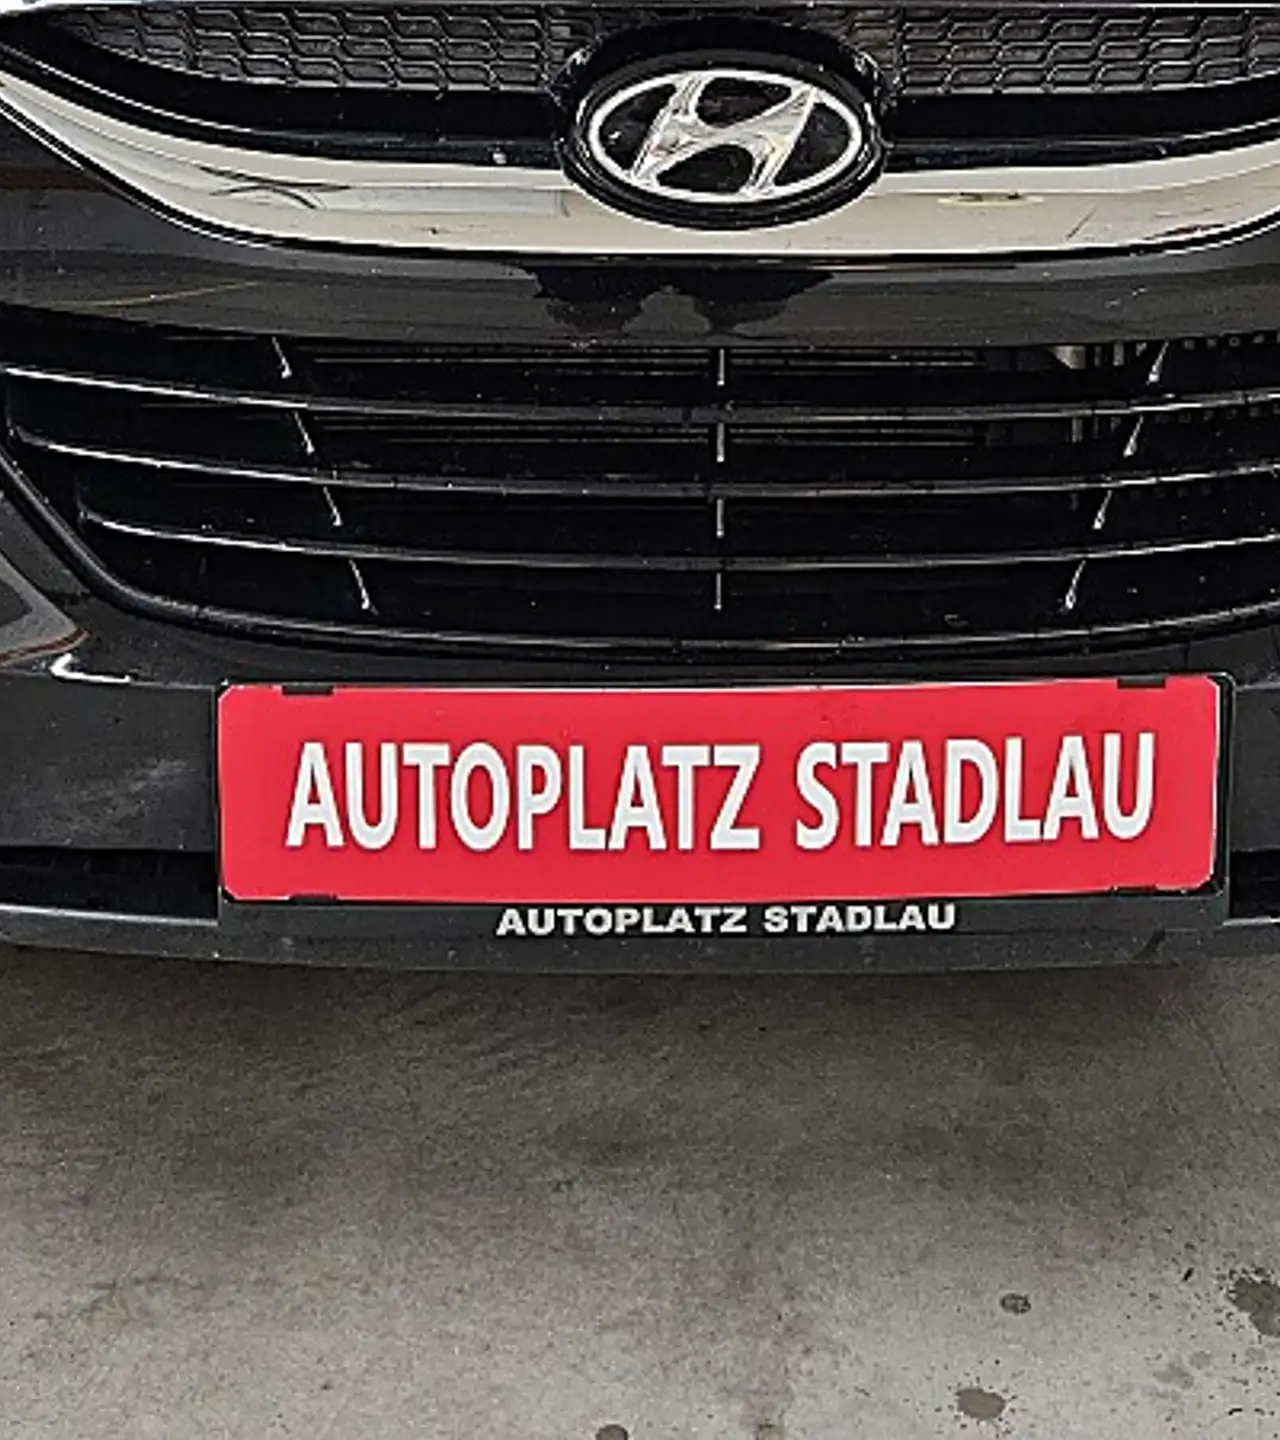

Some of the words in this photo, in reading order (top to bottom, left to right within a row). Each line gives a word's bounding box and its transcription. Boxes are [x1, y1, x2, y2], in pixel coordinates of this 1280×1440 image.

[285, 741, 761, 851] AUTOPLATZ
[795, 731, 1155, 850] STADLAU
[496, 906, 748, 936] AUTOPLATZ
[763, 903, 956, 933] STADLAU
